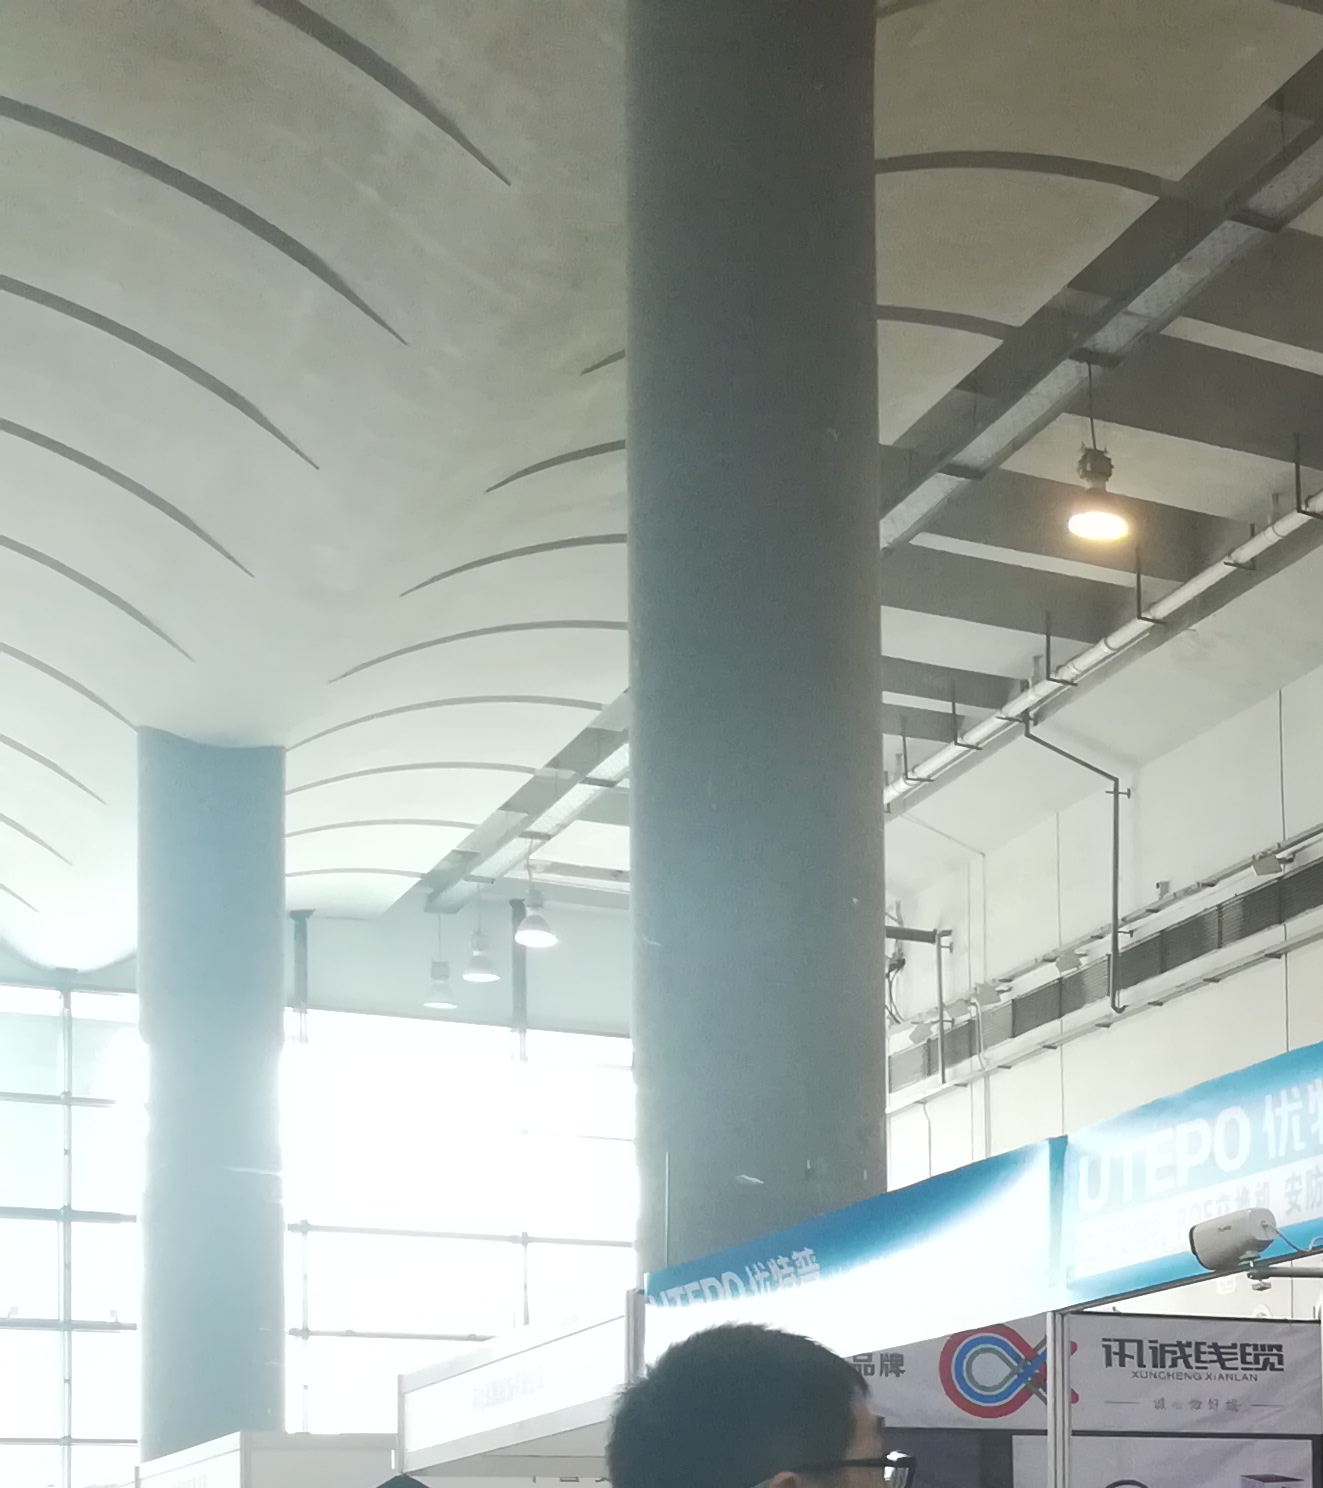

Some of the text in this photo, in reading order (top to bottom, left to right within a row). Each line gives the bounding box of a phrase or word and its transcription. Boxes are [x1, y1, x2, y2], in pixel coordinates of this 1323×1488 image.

[1077, 1106, 1250, 1213] UTEPO
[1101, 1337, 1285, 1372] 讯诚线缆
